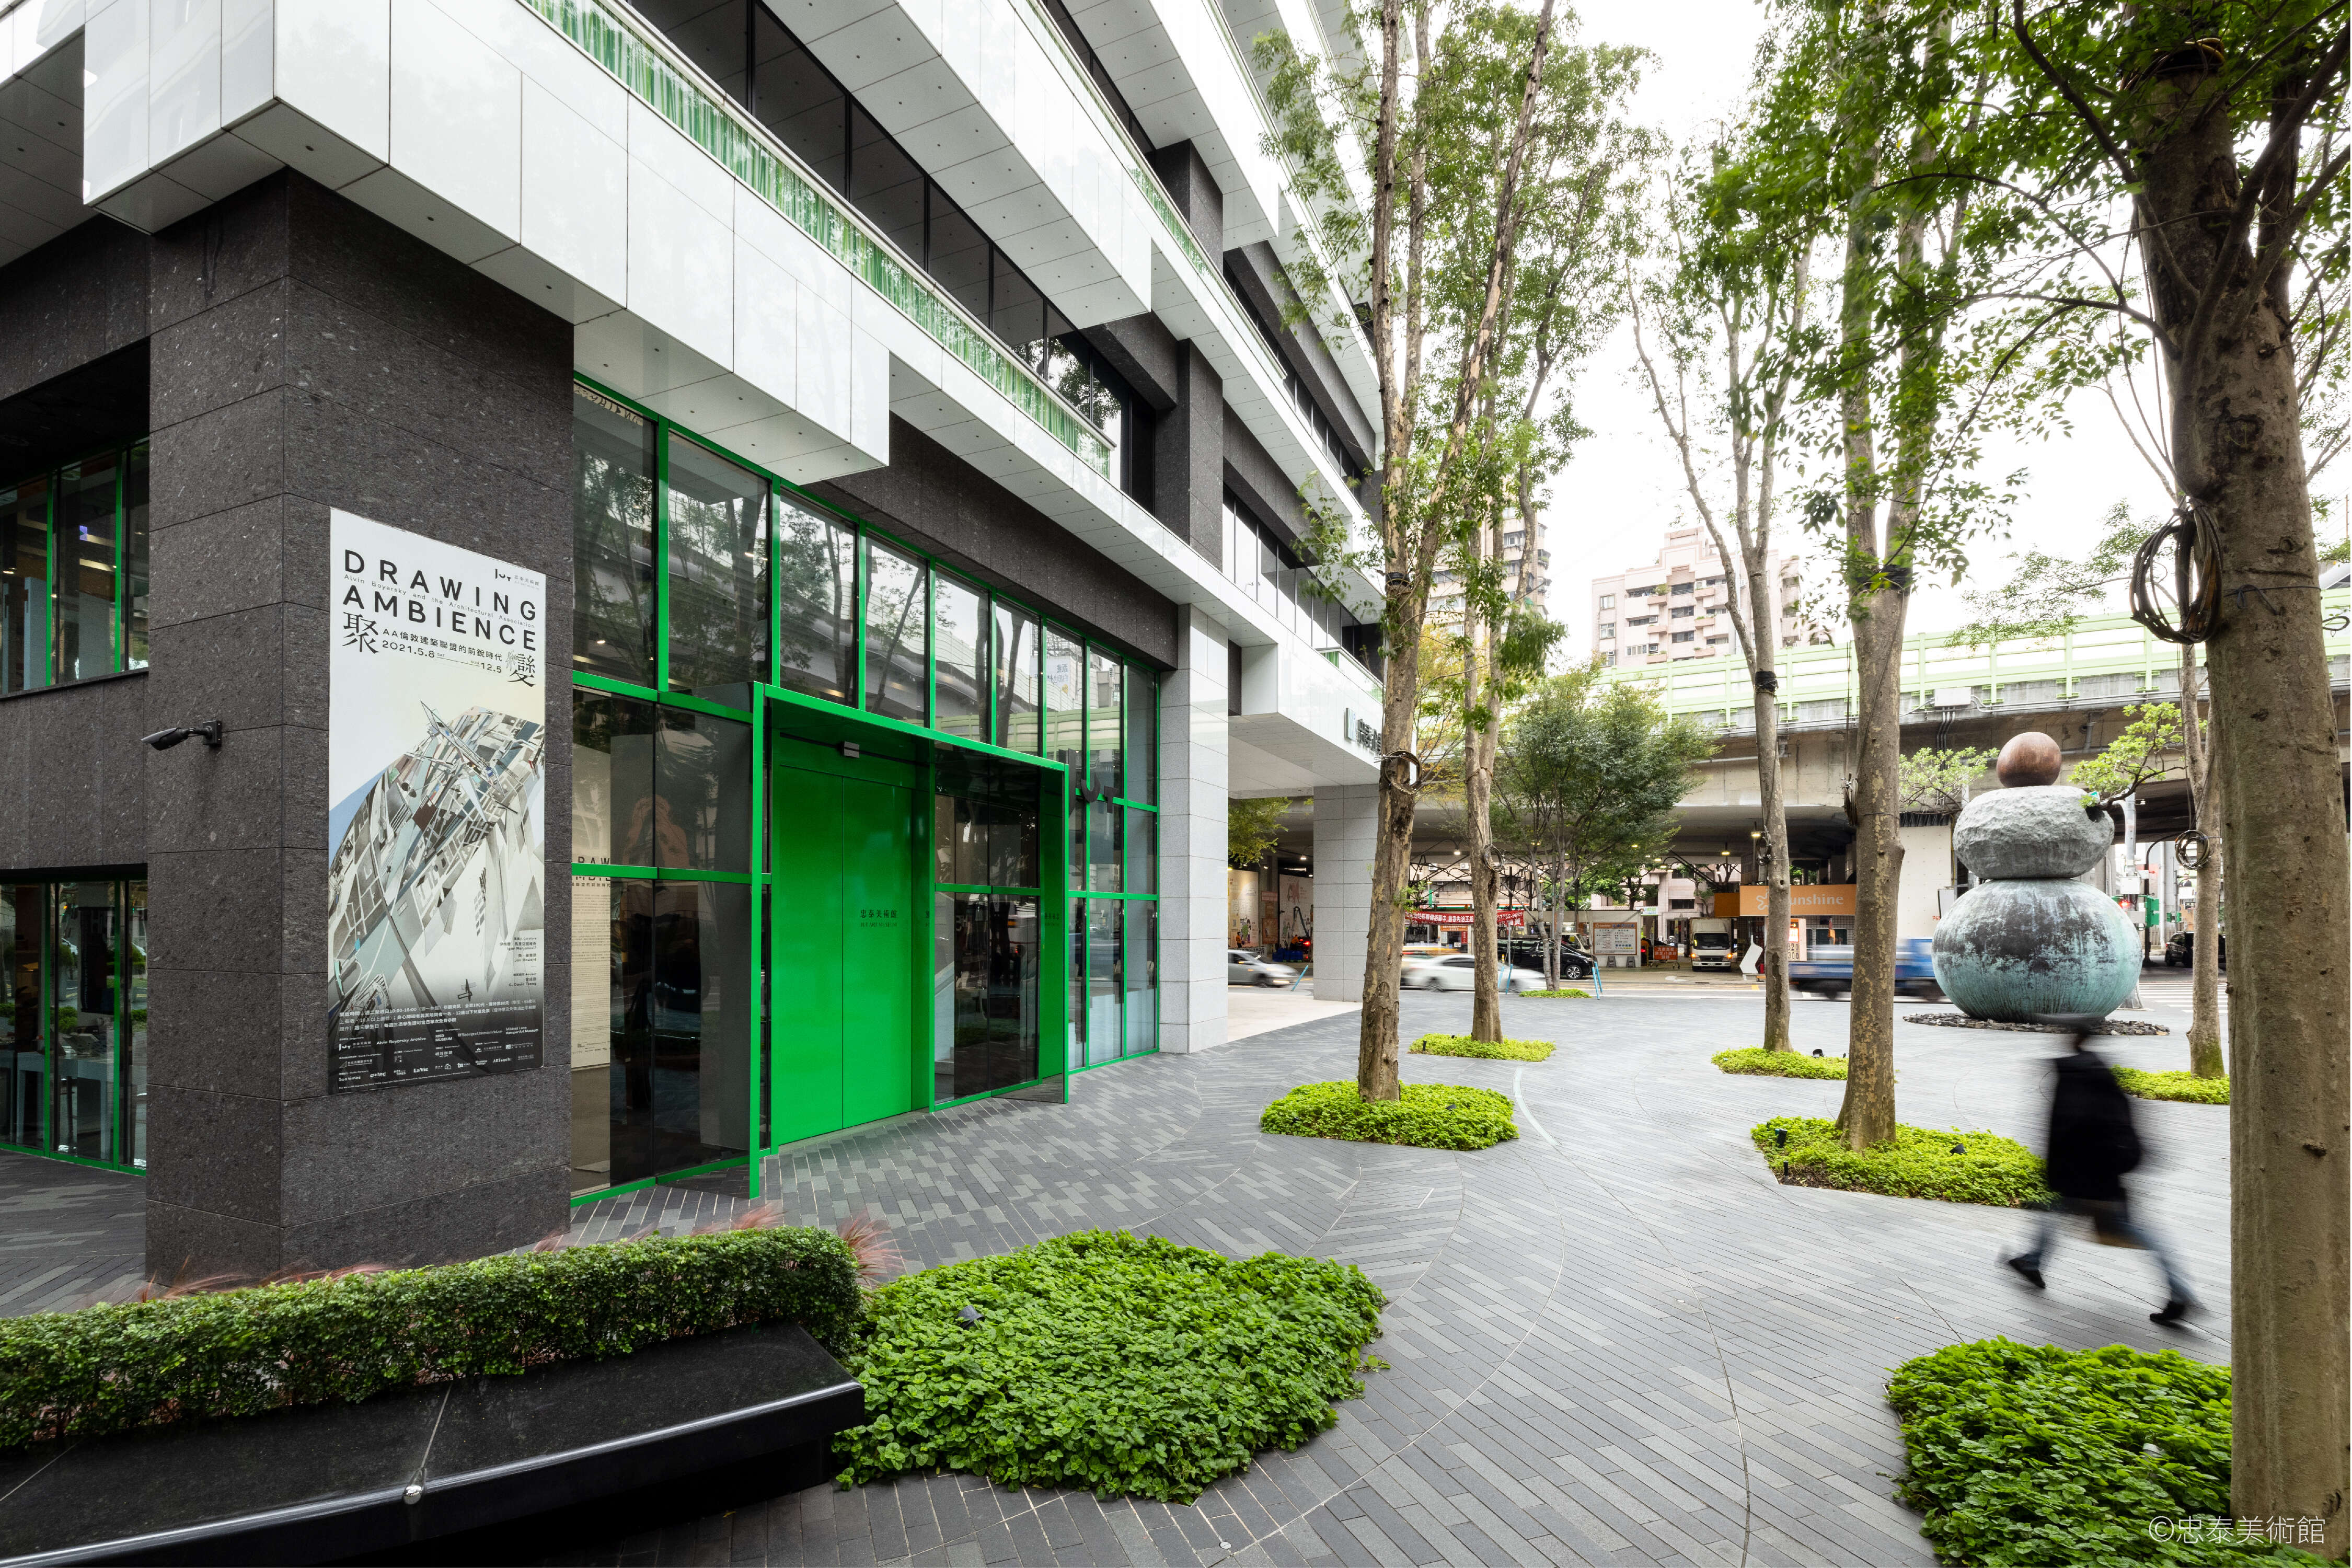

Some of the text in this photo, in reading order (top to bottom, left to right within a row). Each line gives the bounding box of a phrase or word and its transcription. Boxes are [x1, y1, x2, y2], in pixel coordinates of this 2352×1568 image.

[344, 574, 364, 584] Alvin
[372, 581, 407, 595] Boyarsky
[449, 602, 493, 618] Architectural
[499, 615, 535, 628] Association
[345, 549, 536, 620] DRAWING
[342, 612, 379, 654] 聚
[343, 585, 536, 651] AMBIENCE
[382, 640, 435, 658] 2021.5.8
[481, 662, 502, 673] 12.5
[1790, 894, 1844, 905] unshine
